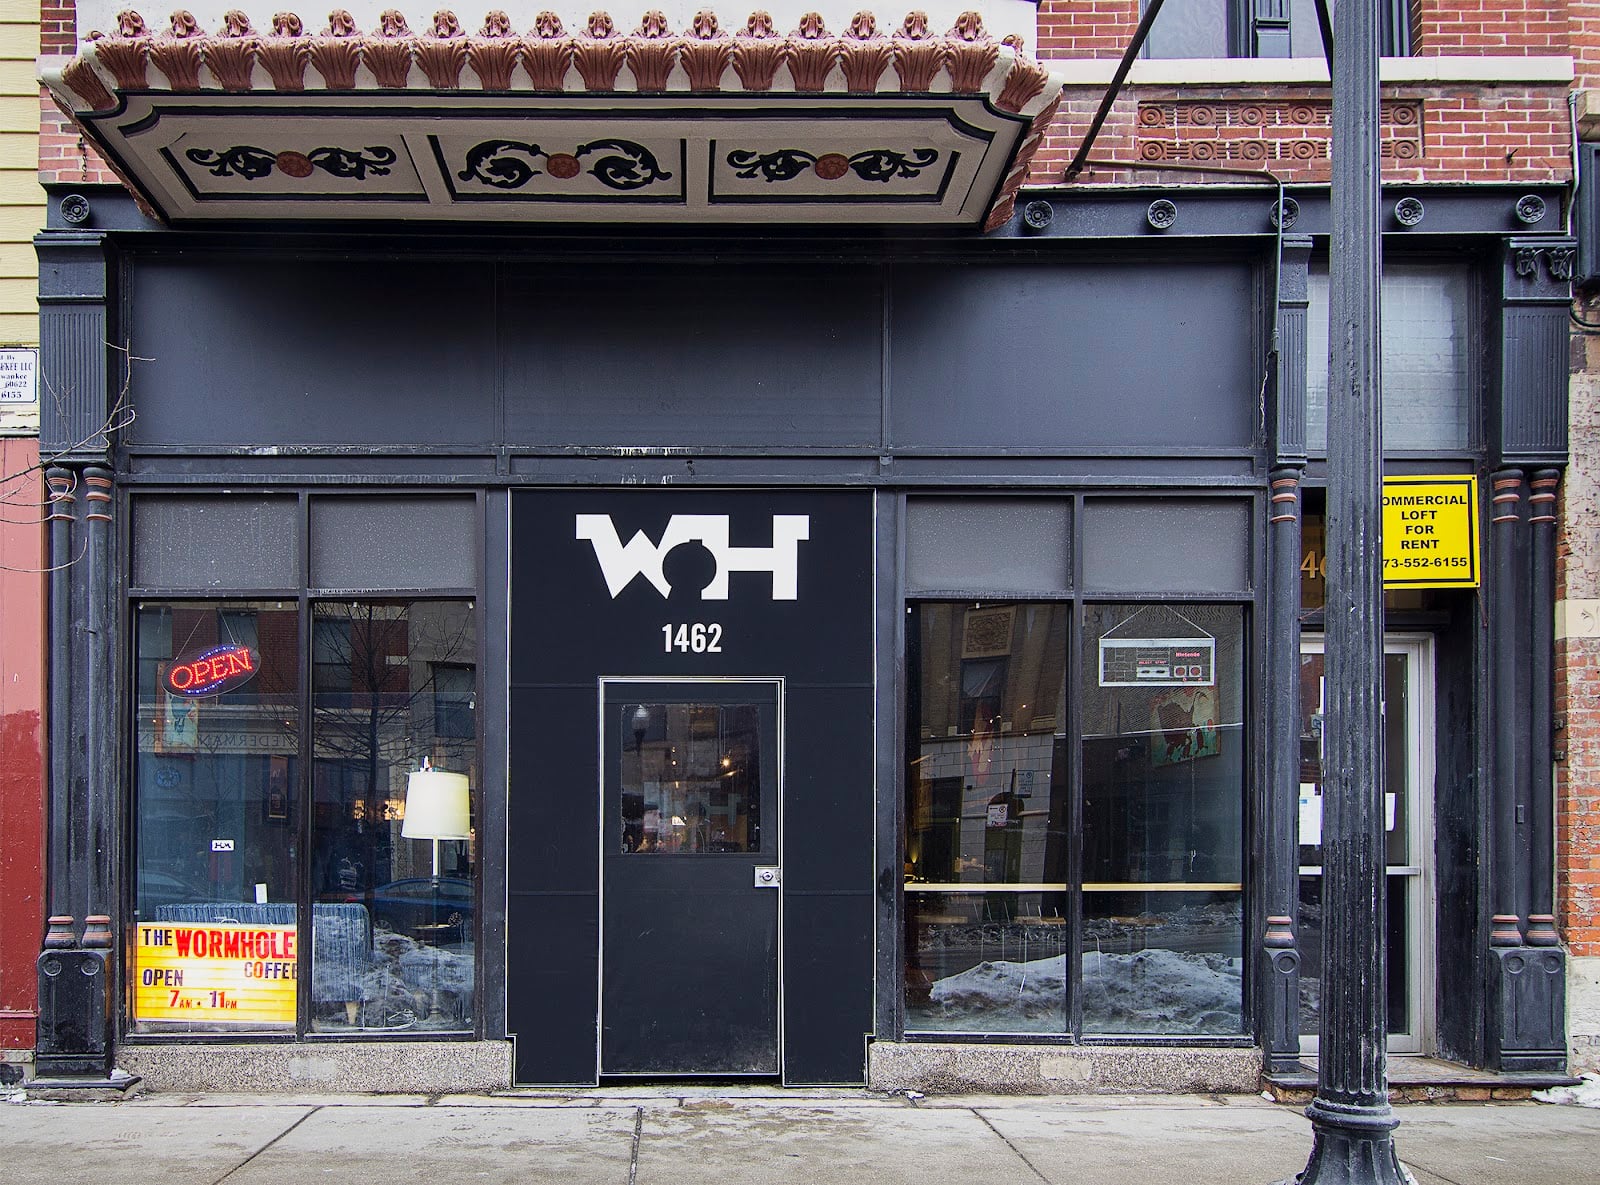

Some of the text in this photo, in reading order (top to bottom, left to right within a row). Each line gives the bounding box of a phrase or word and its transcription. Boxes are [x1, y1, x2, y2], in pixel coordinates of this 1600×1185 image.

[20, 362, 33, 371] LLC
[1383, 495, 1467, 506] OMMERCIAL
[1401, 510, 1438, 521] LOFT
[1405, 525, 1434, 535] FOR
[1400, 539, 1440, 550] RENT
[1383, 557, 1468, 569] 73-552-6155
[662, 623, 722, 653] 1462
[169, 648, 253, 691] OPEN
[143, 928, 296, 959] THE WORMHOLE
[142, 968, 184, 987] OPEN
